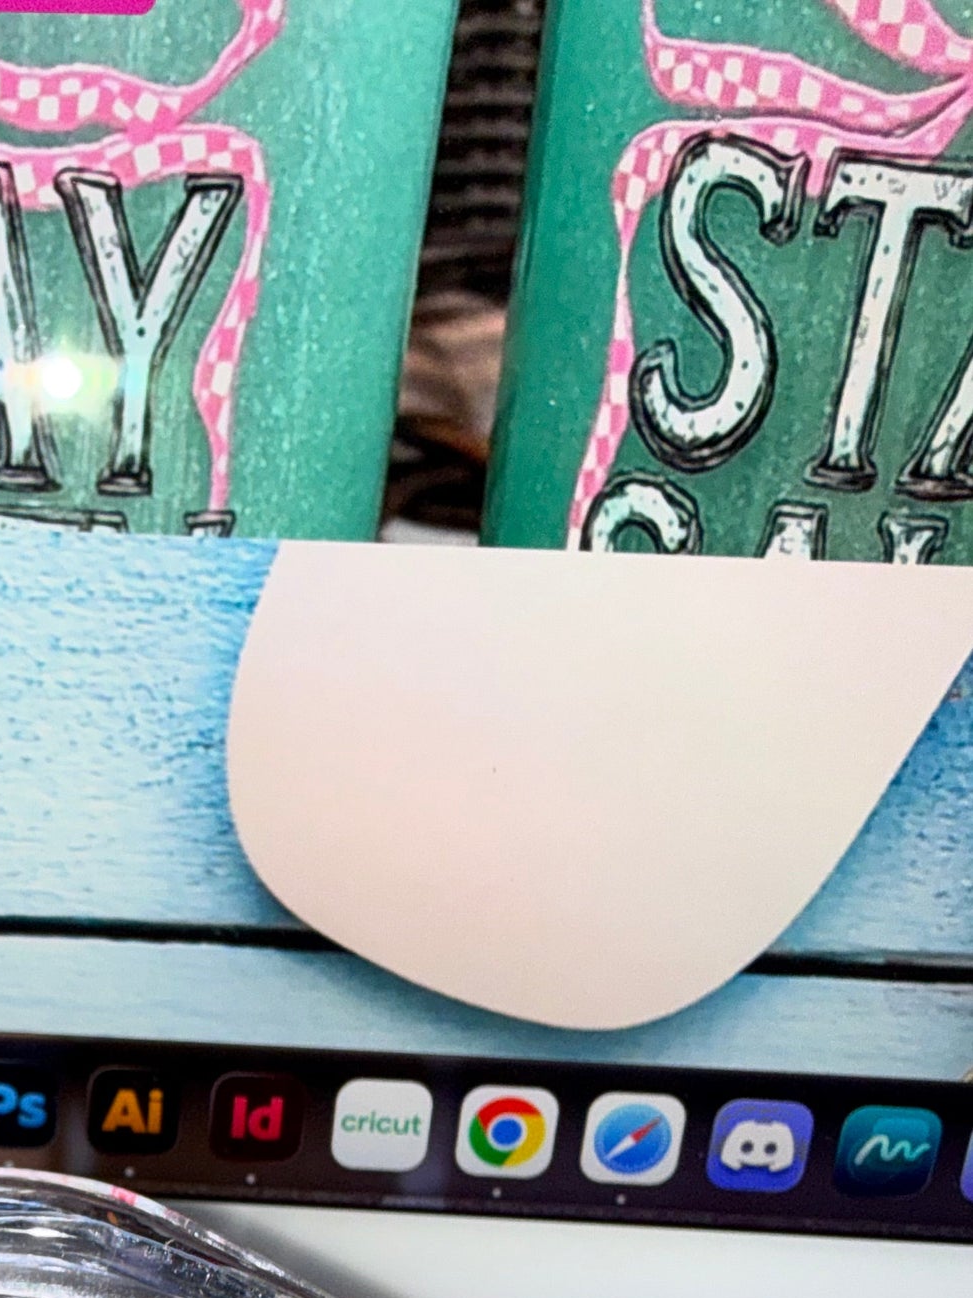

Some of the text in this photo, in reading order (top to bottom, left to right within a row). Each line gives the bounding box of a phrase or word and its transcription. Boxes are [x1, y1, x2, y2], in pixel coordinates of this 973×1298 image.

[101, 1088, 164, 1135] Ai
[230, 1095, 284, 1142] Id
[340, 1107, 423, 1138] cricut
